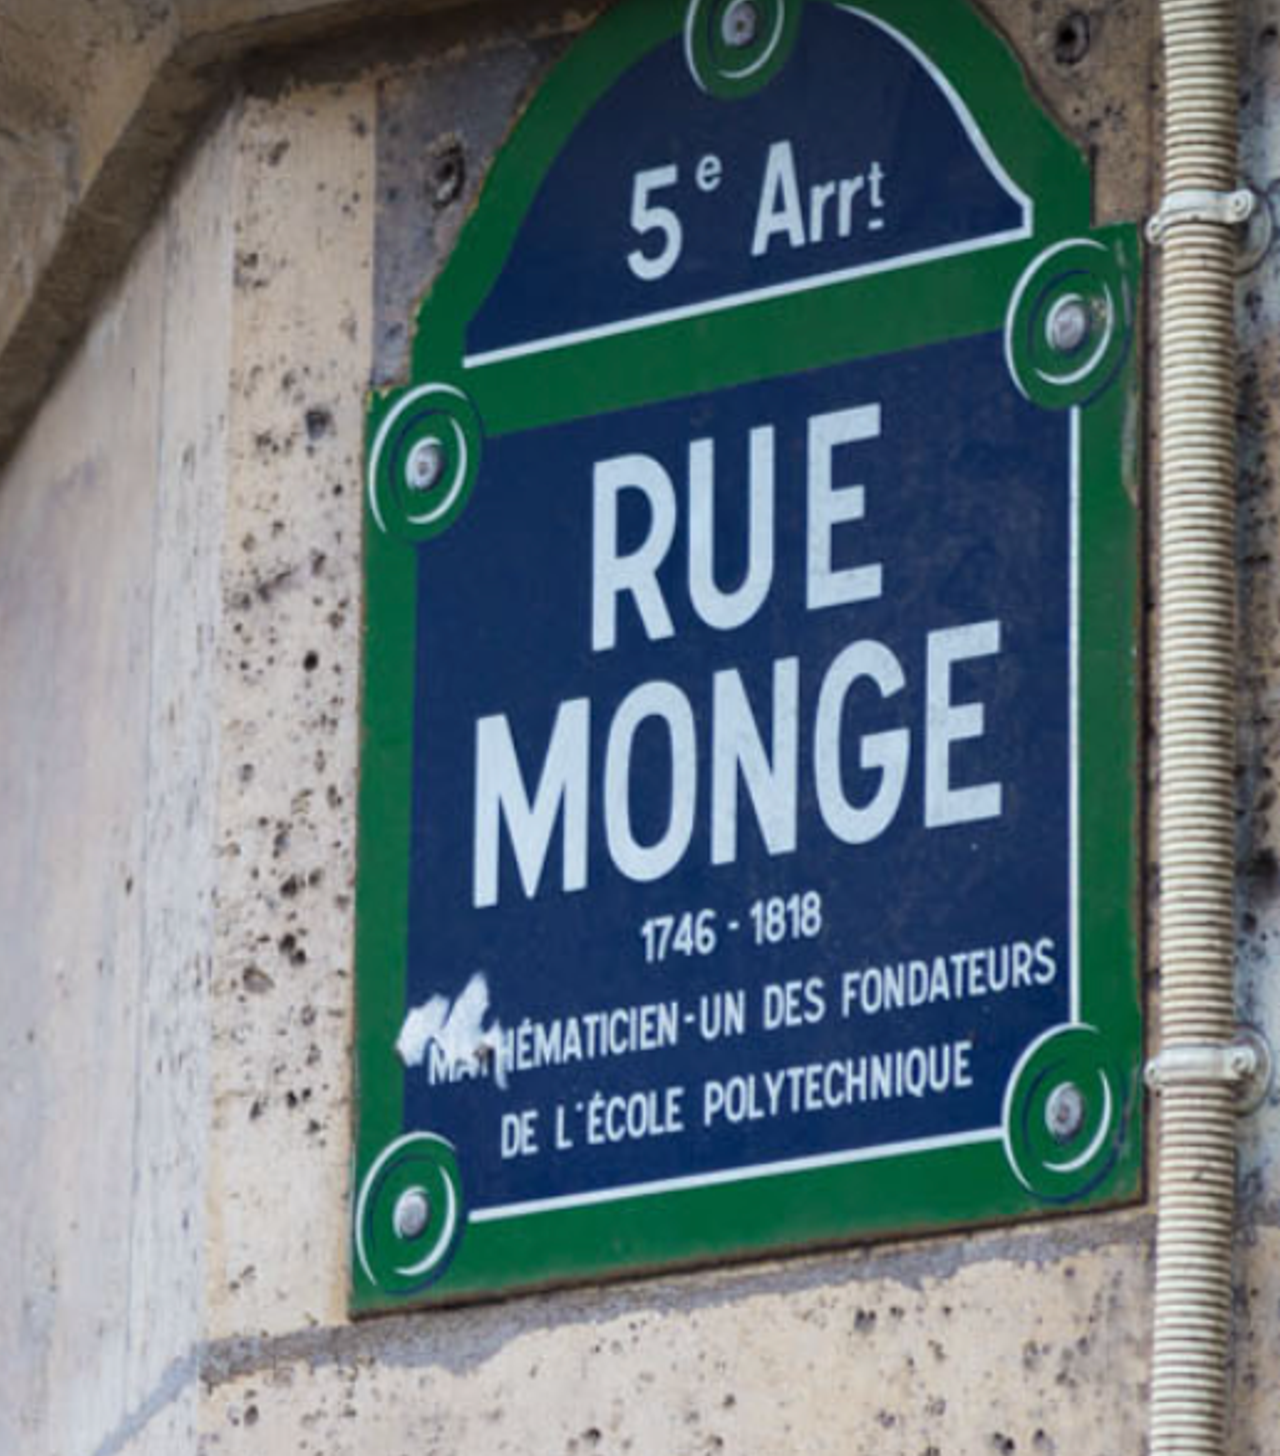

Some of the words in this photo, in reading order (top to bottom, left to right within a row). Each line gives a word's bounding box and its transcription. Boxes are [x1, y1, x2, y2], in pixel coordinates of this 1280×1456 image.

[591, 402, 883, 652] RUE
[473, 618, 1003, 908] MONGE
[641, 908, 717, 962] 1746
[750, 890, 822, 945] 1818
[764, 976, 826, 1032] DES
[842, 937, 1057, 1017] FONDATEURS
[501, 1109, 539, 1159] DE
[703, 1040, 973, 1127] POLYTECHNIQUE
